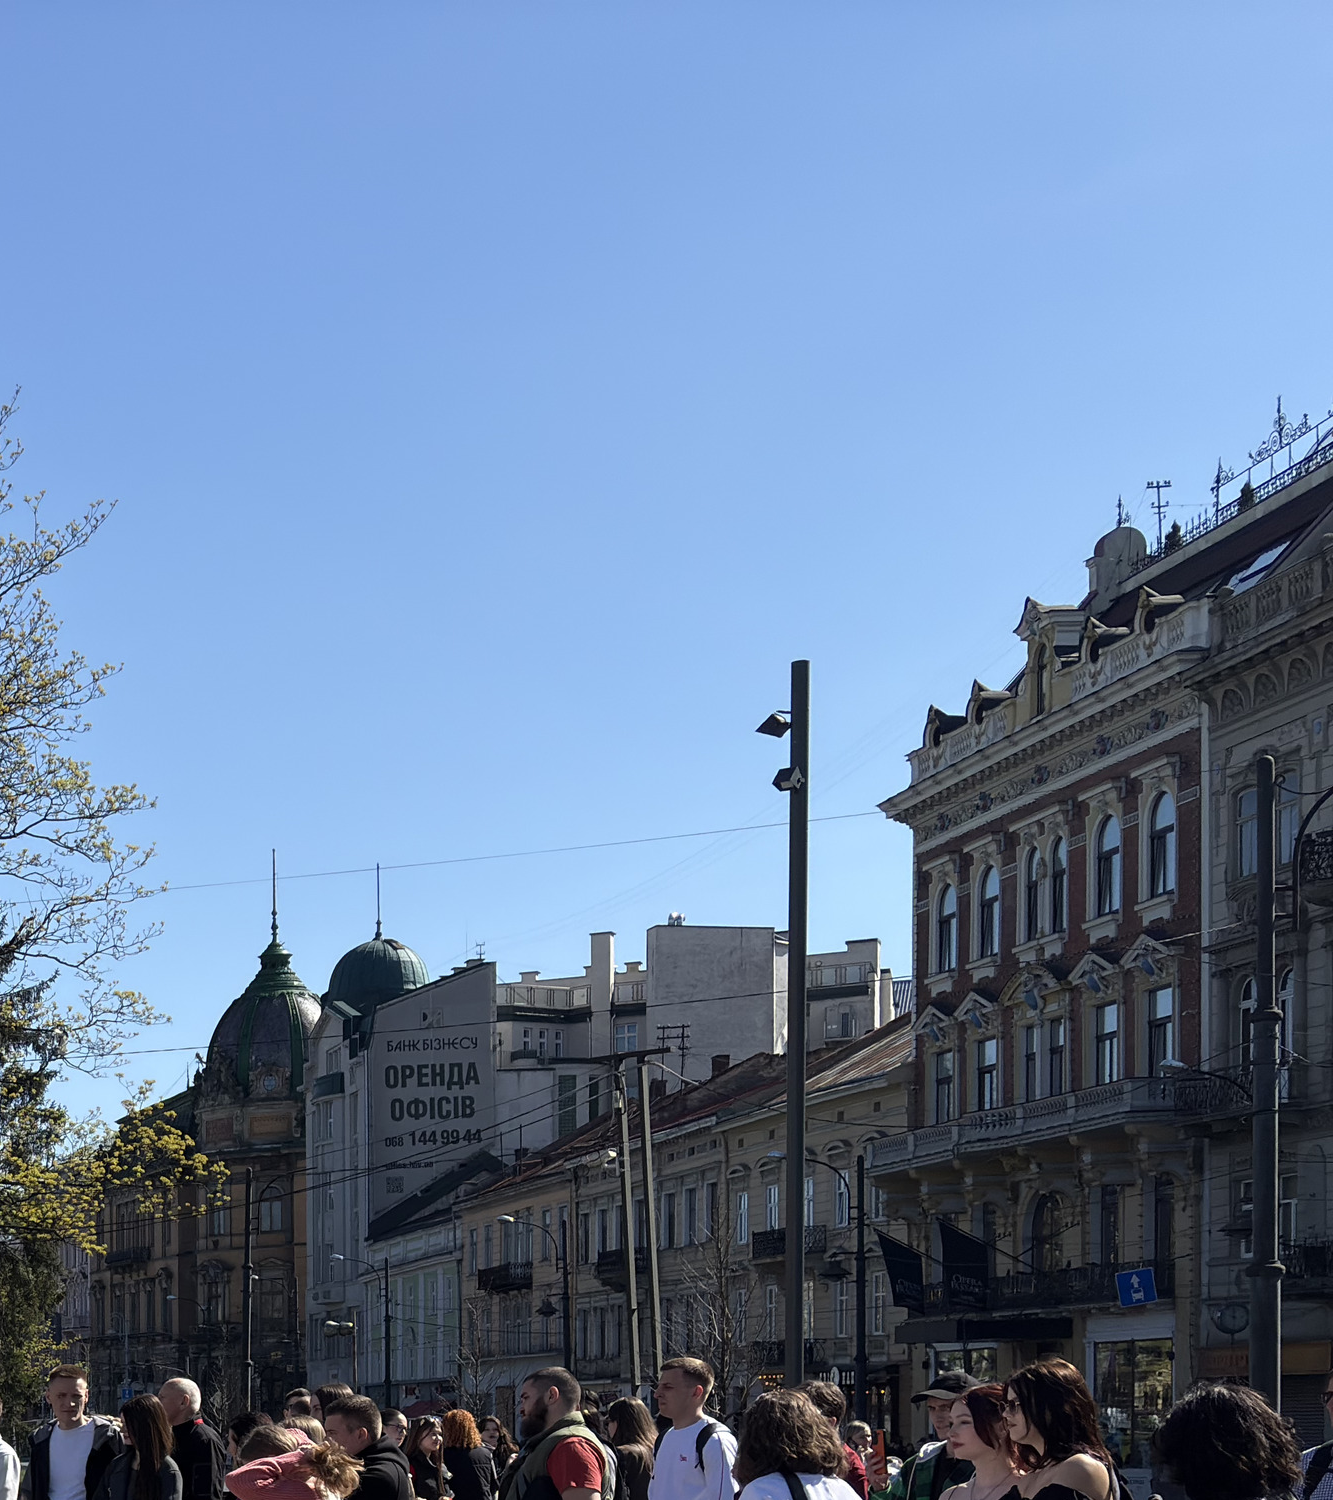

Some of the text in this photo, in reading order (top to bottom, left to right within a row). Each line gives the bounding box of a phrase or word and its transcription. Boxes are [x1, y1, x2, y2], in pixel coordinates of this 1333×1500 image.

[387, 1040, 421, 1053] БАНК
[385, 1062, 480, 1091] ОРЕНДА
[390, 1096, 475, 1122] ОФІСІВ
[385, 1137, 404, 1147] 068
[408, 1130, 438, 1146] 144
